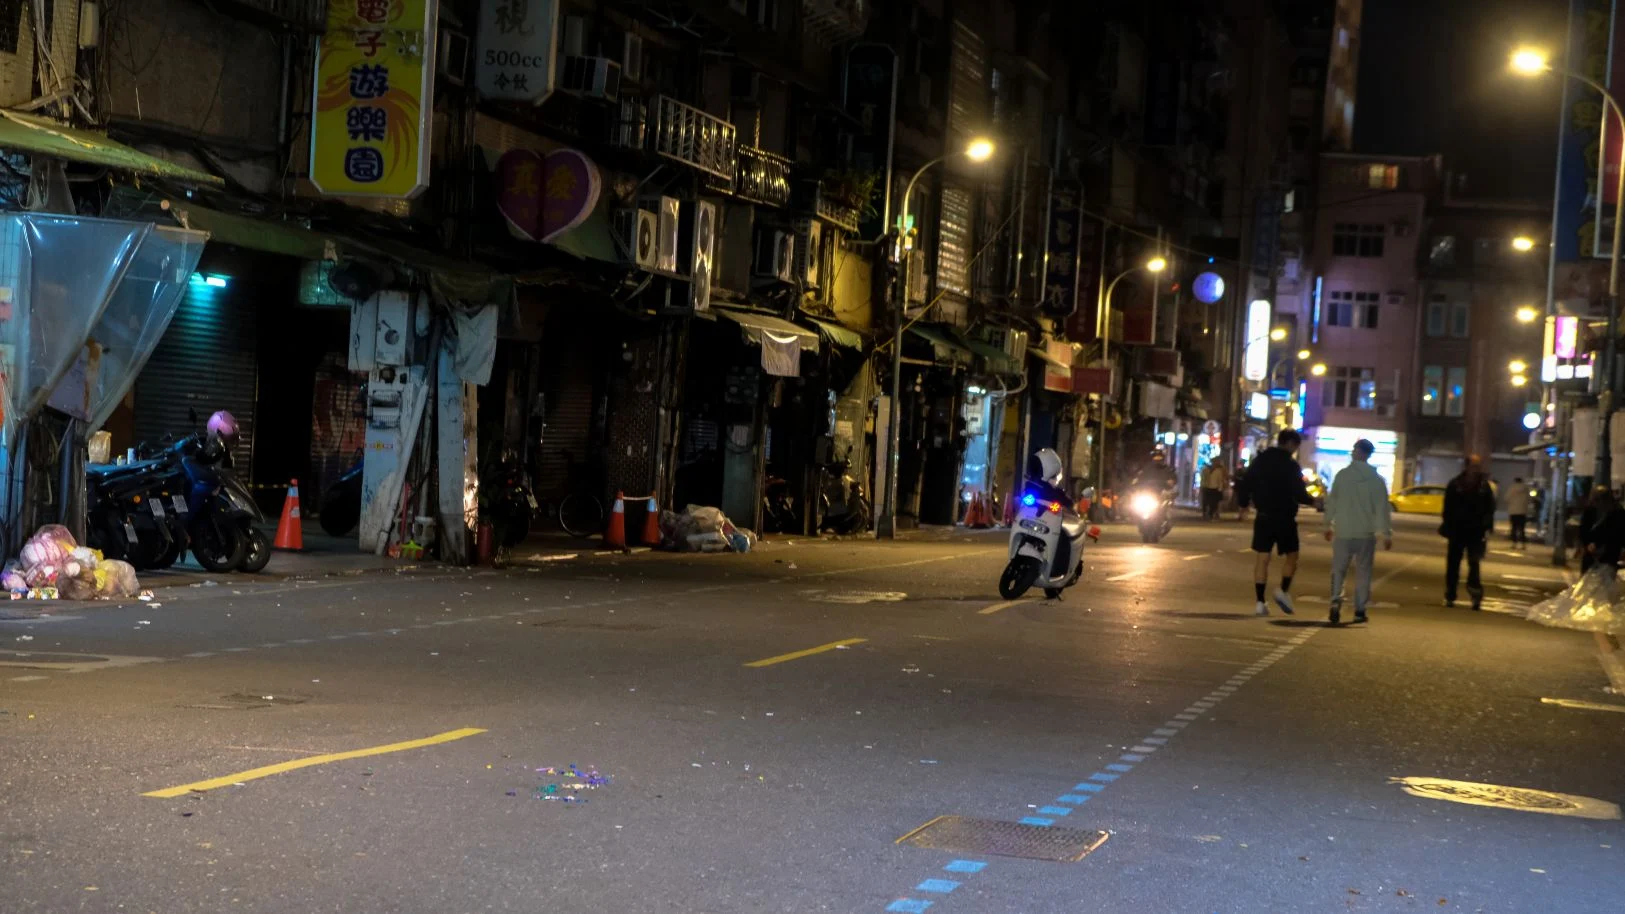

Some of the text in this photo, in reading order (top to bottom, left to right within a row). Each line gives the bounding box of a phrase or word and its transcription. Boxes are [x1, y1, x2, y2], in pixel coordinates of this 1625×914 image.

[484, 49, 542, 68] 500cc
[344, 0, 389, 182] 電子遊樂園
[493, 71, 529, 92] 冷飲
